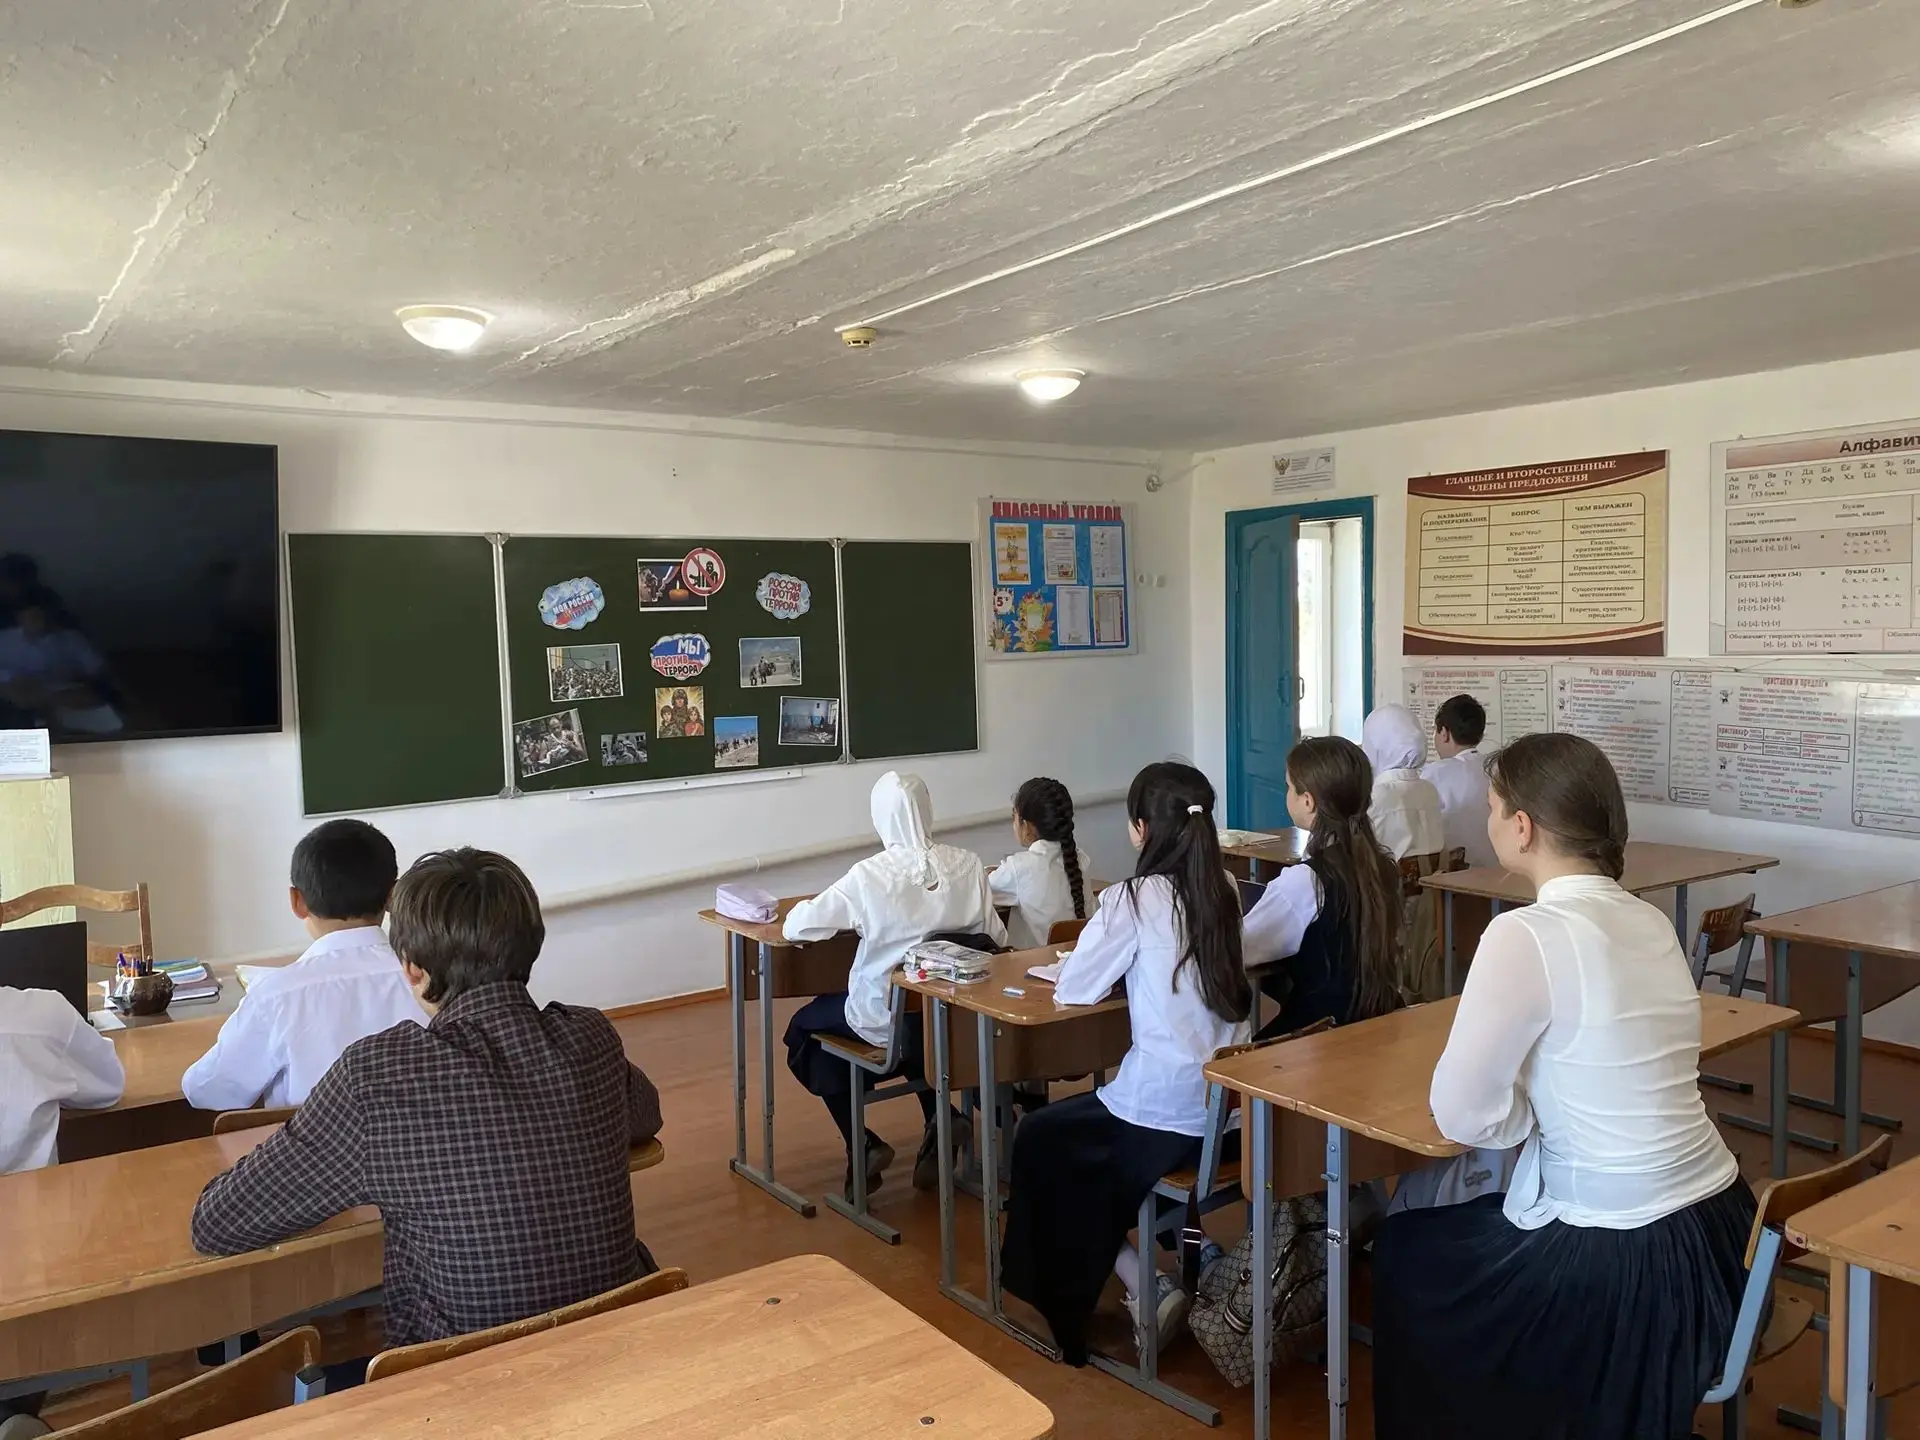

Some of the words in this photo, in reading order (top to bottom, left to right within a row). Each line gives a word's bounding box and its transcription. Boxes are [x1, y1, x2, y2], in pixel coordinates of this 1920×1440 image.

[1445, 472, 1495, 486] ГЛАВНЫЕ
[1496, 471, 1504, 480] И
[1506, 460, 1617, 478] ВТОРОСТЕПЕННЫЕ
[1468, 481, 1507, 492] ЧЛЕНЫ
[1509, 473, 1589, 489] ПРЕДЛОЖЕНЯ
[992, 500, 1069, 520] КЛАССНЫЙ
[1072, 504, 1121, 521] УГОЛОК
[1511, 509, 1541, 517] ВОПРОС
[1593, 502, 1633, 511] ВЫРАЖЕН
[568, 592, 595, 609] РОССИЯ
[769, 587, 800, 602] ПРОТИВ
[764, 597, 799, 613] ТЕРРОРА
[677, 638, 701, 655] МЫ
[655, 655, 688, 667] ПРОТИВ
[664, 664, 699, 676] ТЕРРОРА
